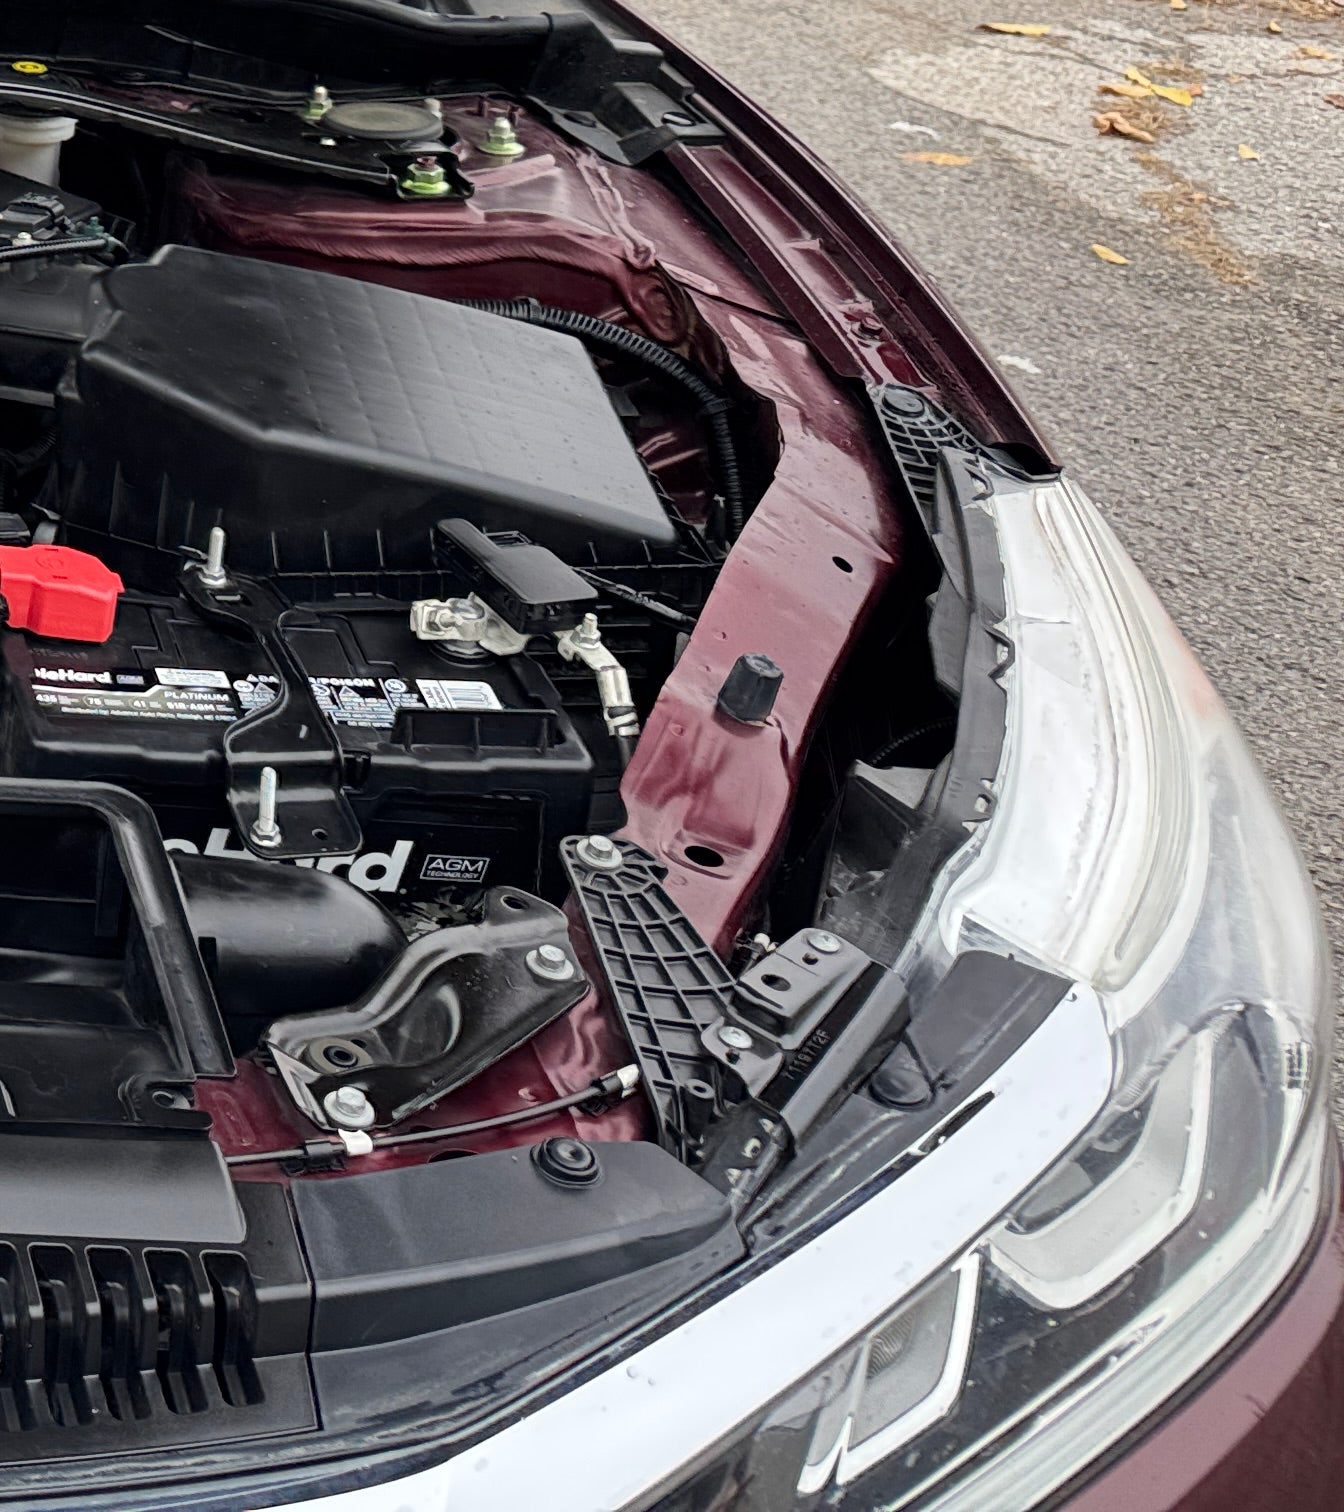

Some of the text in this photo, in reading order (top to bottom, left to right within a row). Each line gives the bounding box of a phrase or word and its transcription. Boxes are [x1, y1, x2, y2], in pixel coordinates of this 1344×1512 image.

[34, 667, 112, 683] ieHard
[164, 690, 230, 702] PLATINUM
[427, 858, 484, 873] AGM
[425, 870, 480, 879] TECHNOLOGY
